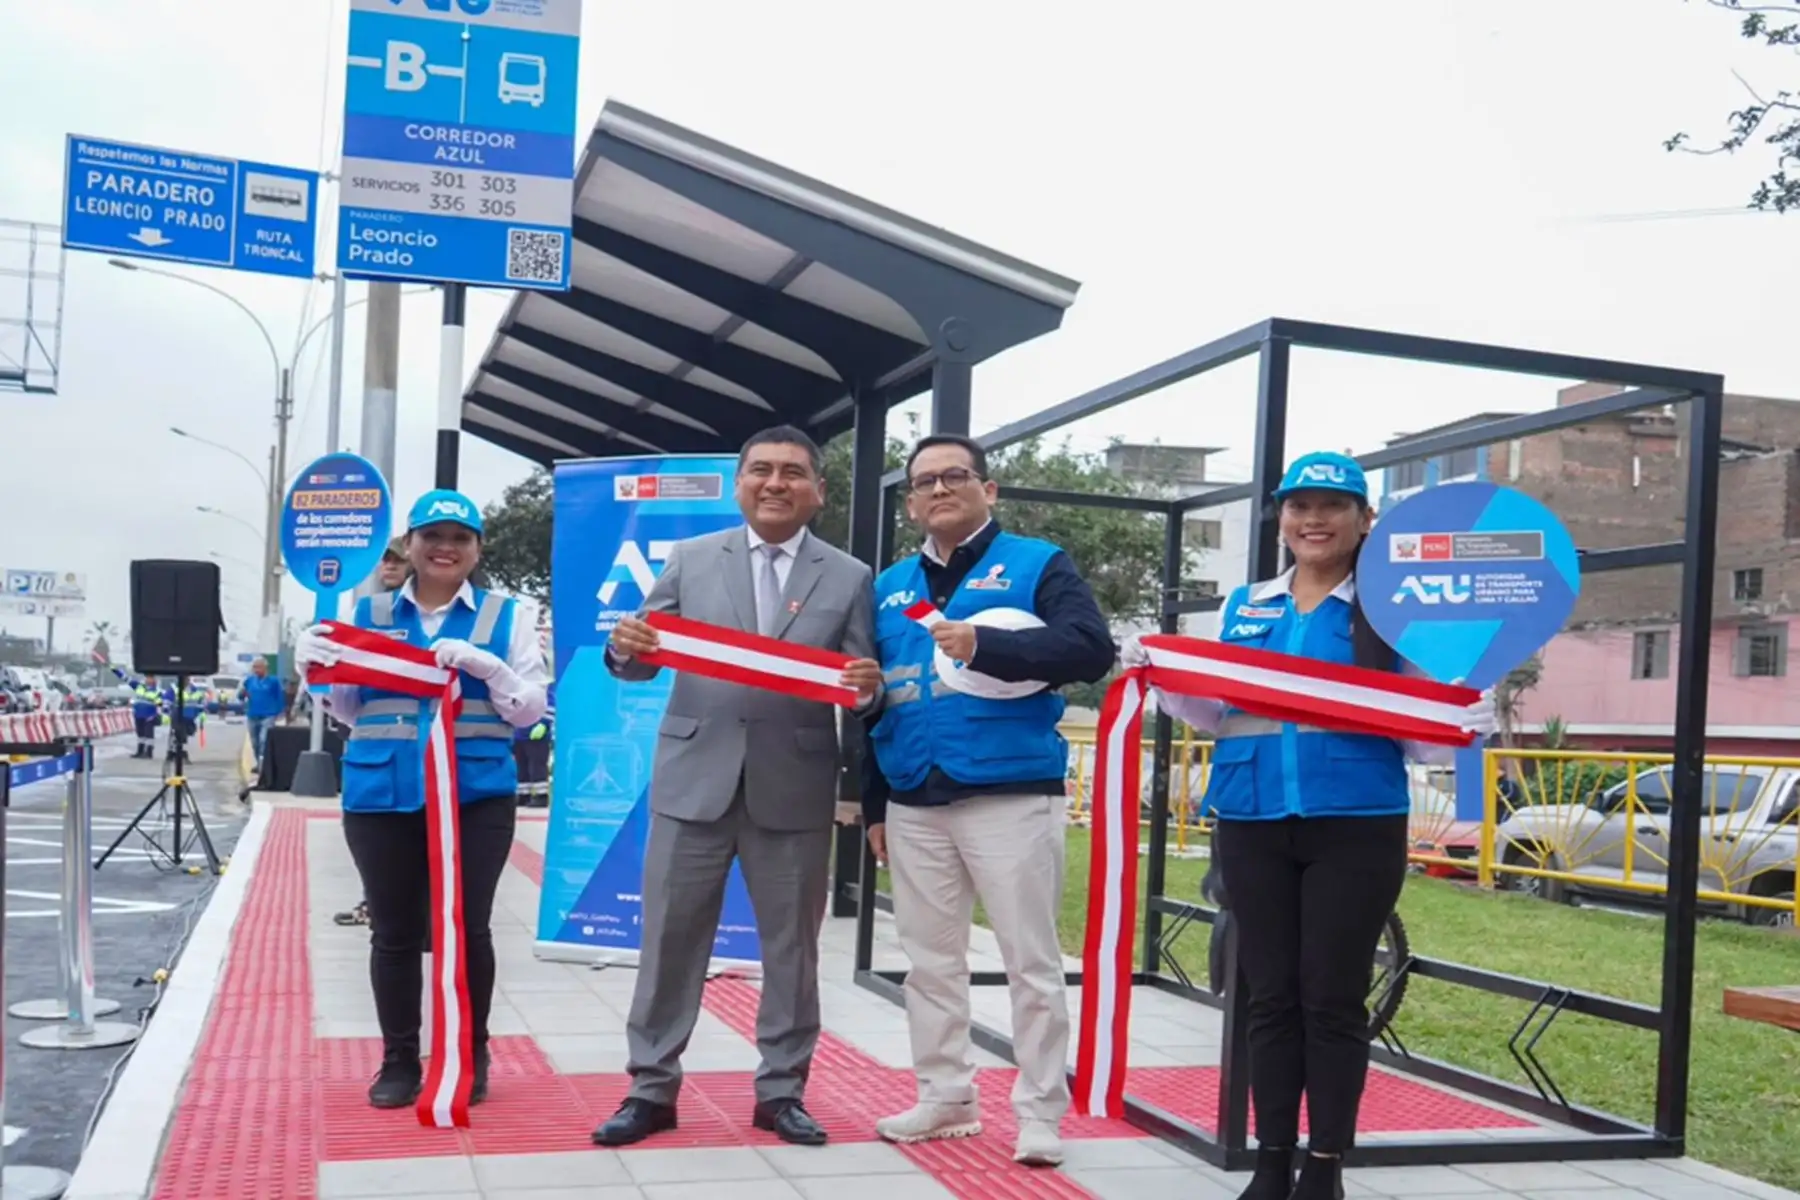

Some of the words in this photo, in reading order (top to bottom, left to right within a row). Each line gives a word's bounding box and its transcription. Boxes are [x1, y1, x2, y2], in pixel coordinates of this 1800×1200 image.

[385, 39, 427, 92] B
[404, 123, 516, 149] CORREDOR
[78, 142, 155, 165] Respetemos
[181, 159, 228, 176] Normas
[434, 146, 485, 164] AZUL
[87, 171, 215, 206] PARADERO
[352, 176, 421, 194] SERVICIOS
[431, 170, 466, 190] 301
[480, 175, 516, 194] 303
[75, 196, 153, 221] LEONCIO
[163, 207, 226, 232] PRADO
[350, 210, 403, 223] PARADERO
[429, 193, 465, 211] 336
[479, 198, 516, 217] 305
[256, 229, 293, 245] RUTA
[350, 223, 438, 248] Leoncio
[244, 243, 305, 263] TRONCAL
[349, 244, 414, 267] Prado
[312, 492, 377, 506] PARADEROS
[324, 511, 373, 524] corredores
[1424, 541, 1448, 551] PERÚ
[1391, 574, 1471, 604] ATU
[1489, 580, 1544, 588] TRANSPORTE
